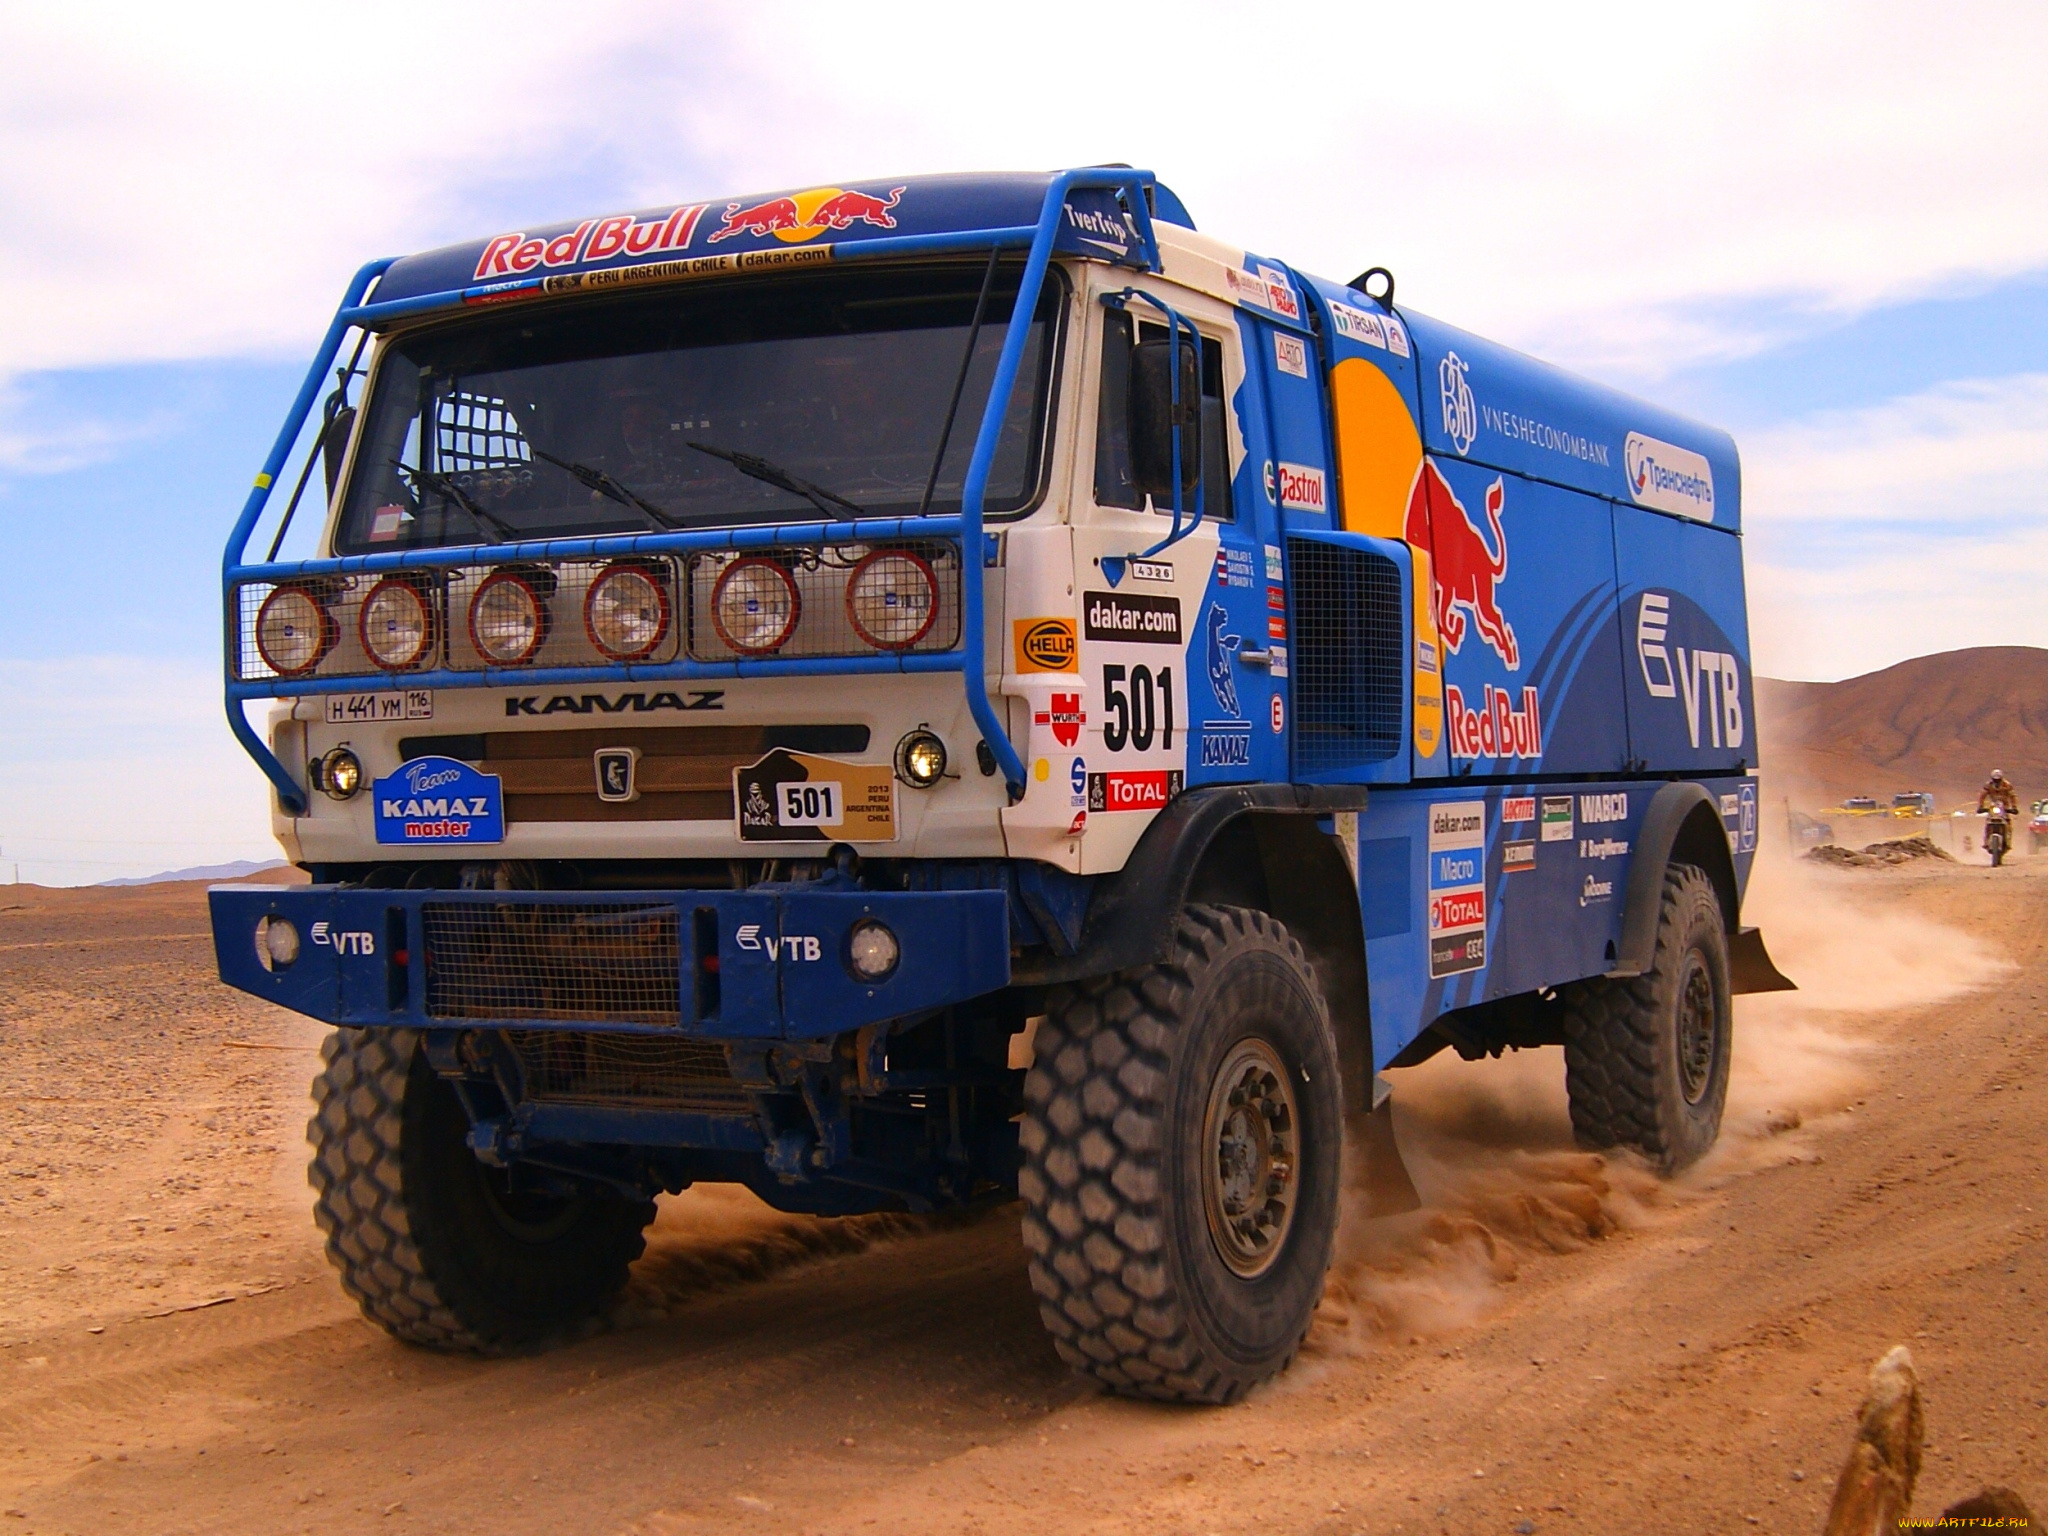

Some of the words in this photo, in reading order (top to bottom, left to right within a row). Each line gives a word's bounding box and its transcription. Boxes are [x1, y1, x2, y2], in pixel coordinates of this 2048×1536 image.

[1063, 203, 1127, 244] TverTrip
[473, 220, 599, 281] Red
[582, 204, 710, 261] Bull
[589, 272, 620, 285] PERU
[623, 261, 691, 281] ARGENTINA
[692, 257, 728, 272] CHILE
[745, 249, 827, 267] dakar.com
[1482, 404, 1611, 468] VNESHECONOMBANK
[1278, 467, 1324, 506] Castrol
[1089, 601, 1178, 633] dakar.com
[1030, 637, 1076, 654] HELLA
[348, 695, 375, 719] 441
[409, 692, 428, 708] 116
[505, 691, 725, 716] KAMAZ
[1103, 664, 1173, 752] 501
[1677, 646, 1744, 749] VTB
[1446, 683, 1498, 759] Red
[1495, 685, 1542, 759] Bull
[1201, 734, 1251, 767] KAMAZ
[404, 762, 461, 795] Team
[867, 785, 890, 793] 2013
[382, 797, 489, 818] KAMAZ
[787, 787, 833, 819] 501
[846, 804, 890, 813] ARGENTINA
[868, 795, 890, 803] PERU
[1580, 793, 1628, 824] WABCO
[405, 820, 471, 838] master
[867, 814, 890, 822] CHILE
[1433, 813, 1481, 834] dakar.com
[1440, 857, 1474, 881] Macro
[332, 931, 375, 955] VTB
[765, 935, 822, 962] VTB
